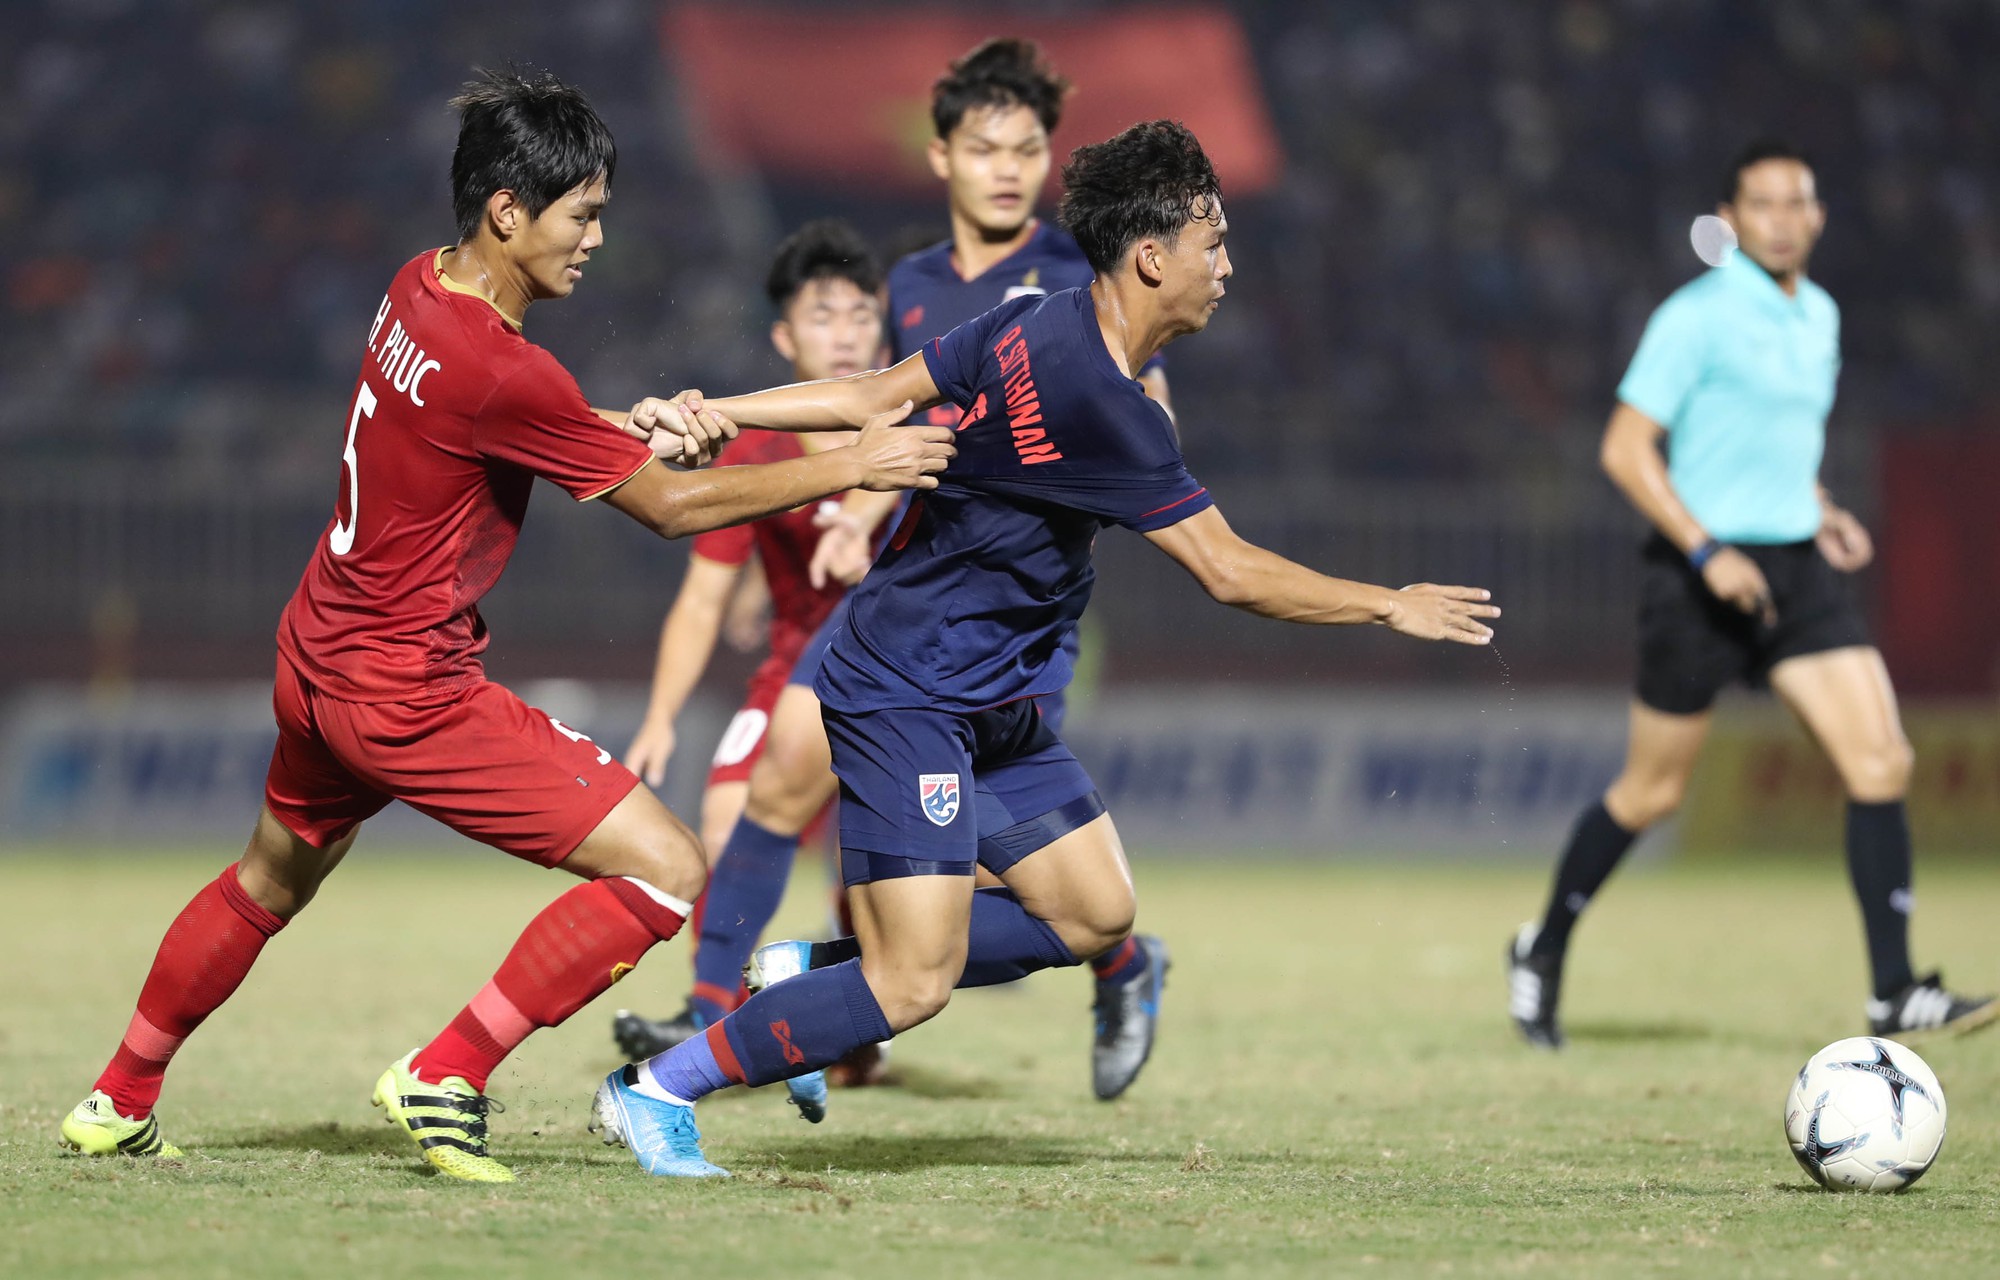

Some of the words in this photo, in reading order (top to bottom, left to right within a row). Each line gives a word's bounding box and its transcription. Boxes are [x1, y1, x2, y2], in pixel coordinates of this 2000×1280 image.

[368, 293, 392, 353] H.
[376, 318, 442, 407] PHUC
[330, 380, 378, 556] 5
[549, 718, 612, 766] 5
[1860, 1063, 1922, 1093] PRIMERO
